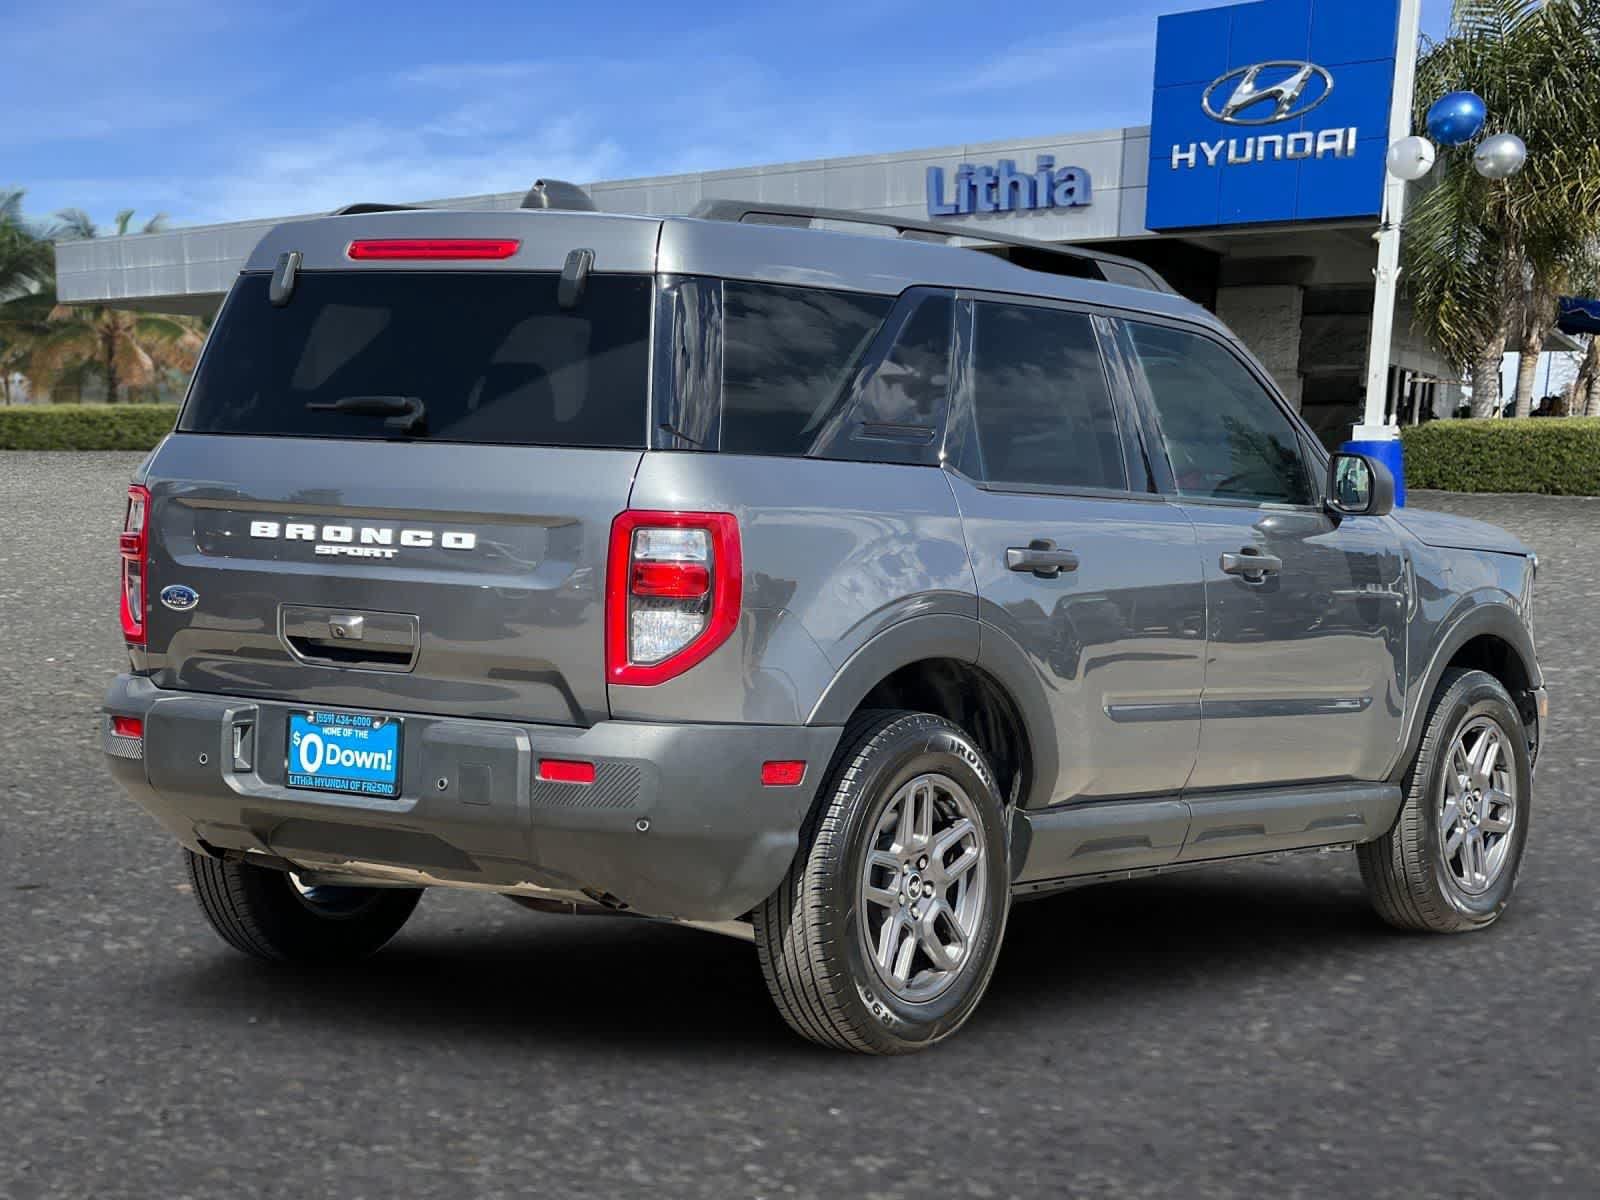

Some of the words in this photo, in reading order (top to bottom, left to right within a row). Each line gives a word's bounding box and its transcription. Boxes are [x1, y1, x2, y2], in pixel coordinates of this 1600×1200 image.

[1171, 127, 1357, 169] HYUNDAI
[926, 155, 1092, 215] Lithia
[250, 521, 475, 549] BRONCO
[315, 545, 399, 558] SPORT
[316, 711, 335, 725] (559)
[322, 727, 342, 737] HOME
[343, 728, 353, 737] OF
[355, 729, 369, 739] THE
[326, 743, 392, 771] Down!
[289, 775, 314, 785] LITHIA
[315, 777, 348, 789] HYUNDAI
[350, 781, 360, 790] OF
[361, 782, 393, 794] FRESNO
